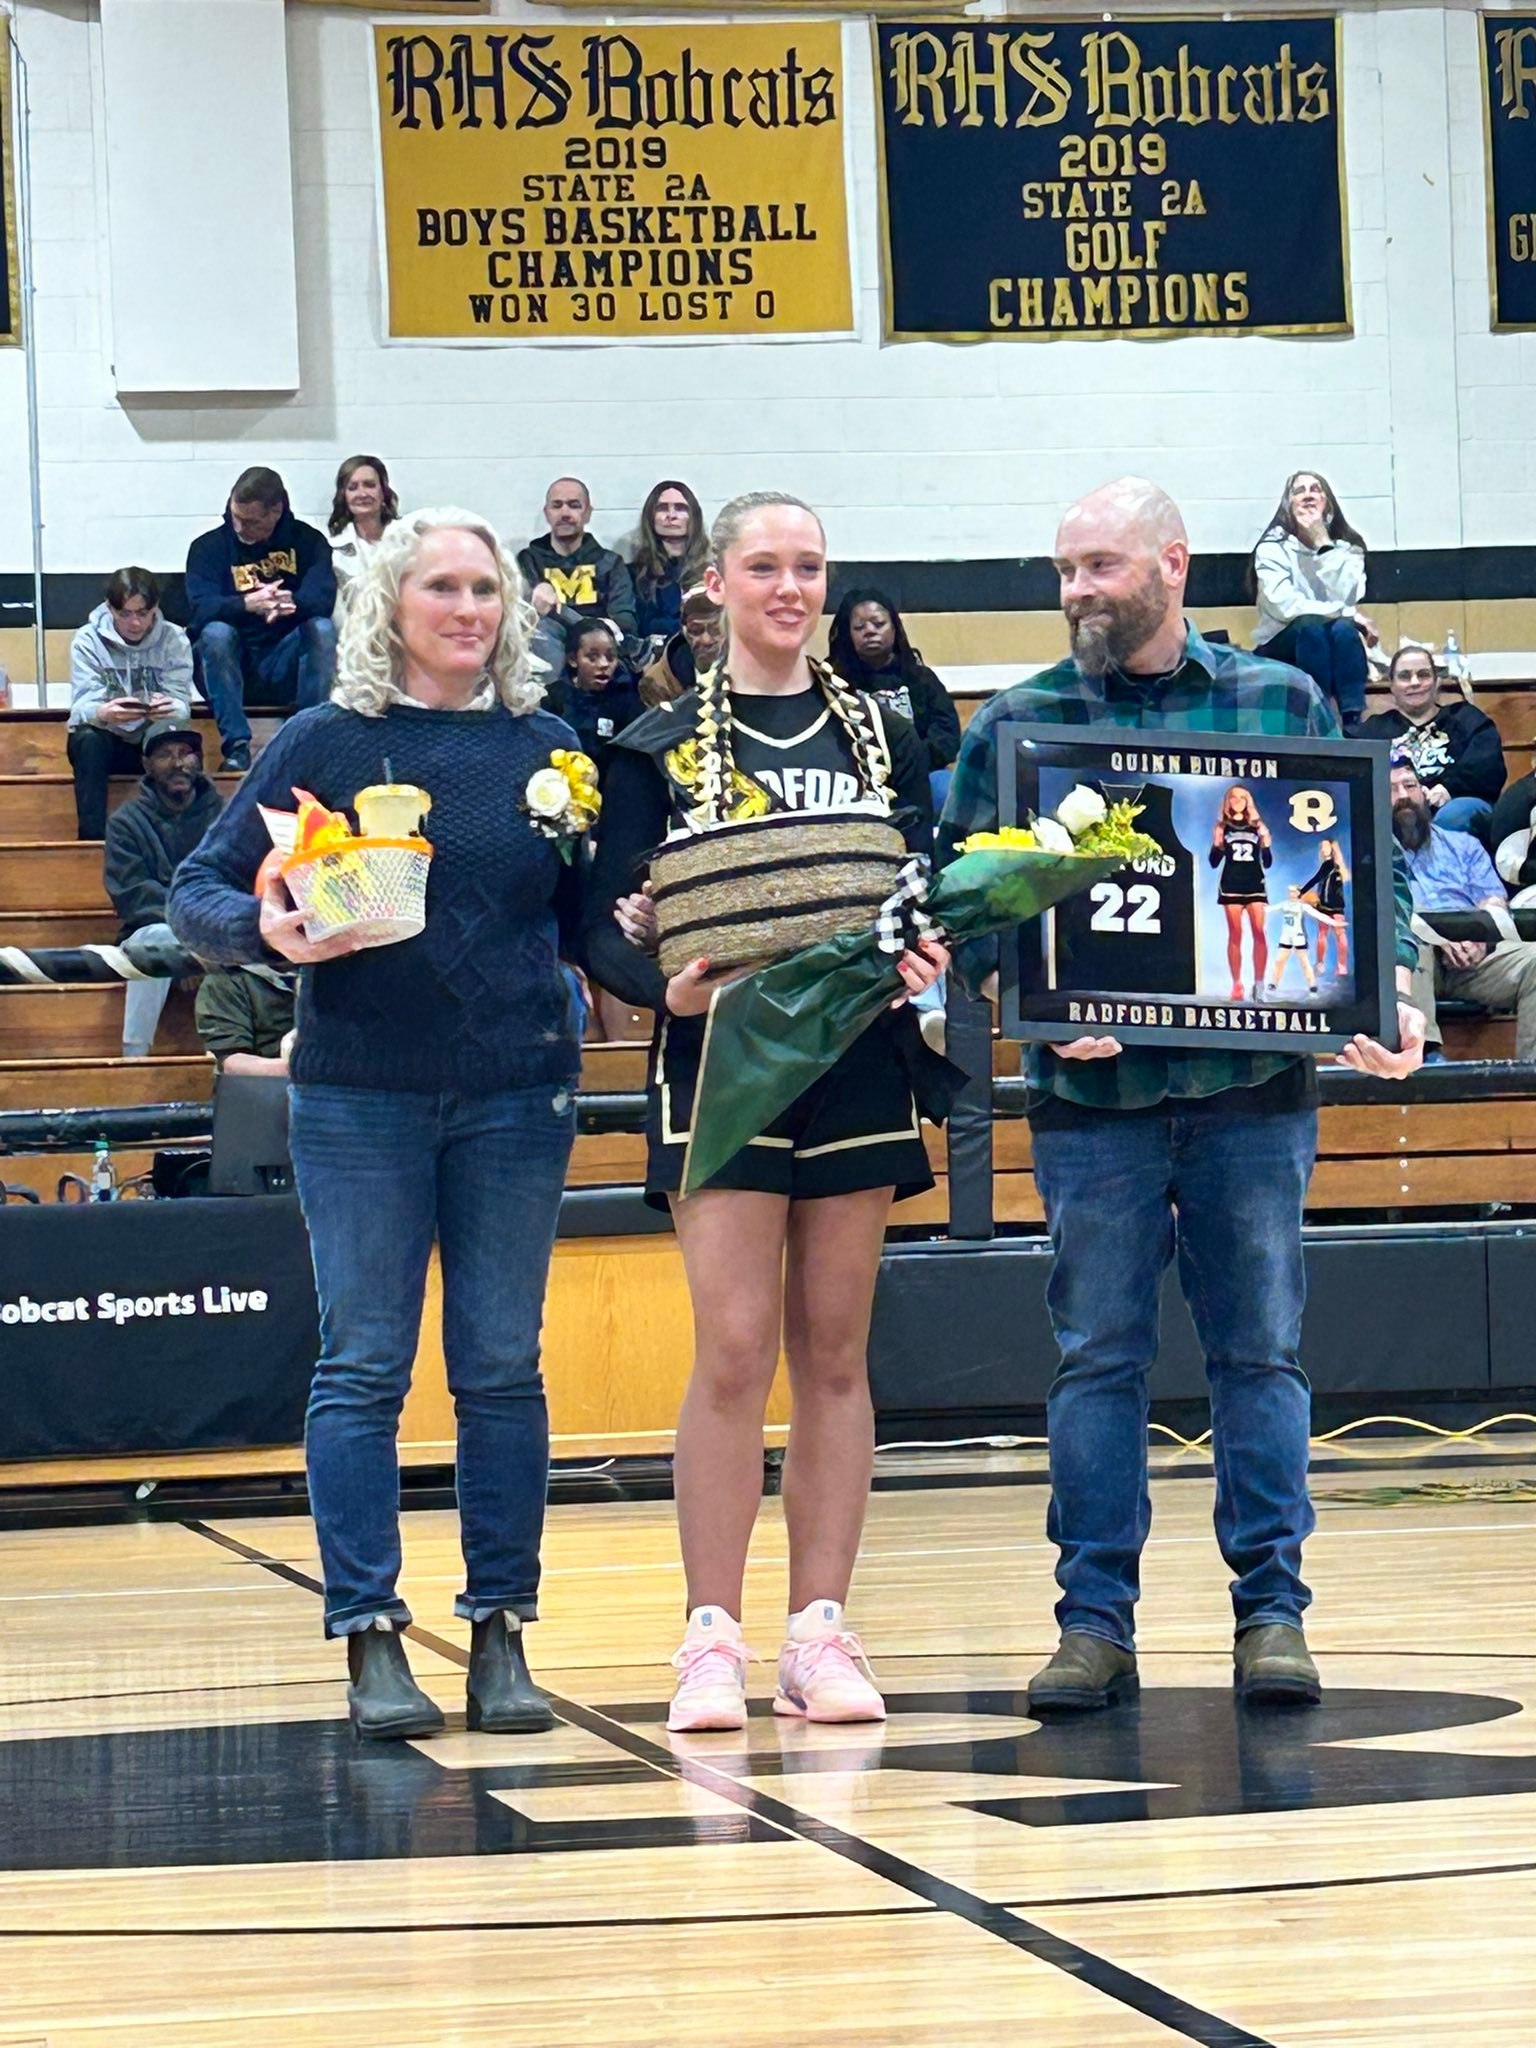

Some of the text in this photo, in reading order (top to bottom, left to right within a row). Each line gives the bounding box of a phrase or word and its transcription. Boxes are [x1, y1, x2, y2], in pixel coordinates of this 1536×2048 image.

[386, 33, 837, 131] RHS Bobcats
[889, 30, 1330, 129] RHS Bobcats
[564, 136, 667, 169] 2019
[1059, 133, 1167, 178] 2019
[523, 173, 711, 203] STATE 2A
[1022, 179, 1207, 219] STATE 2A
[416, 203, 817, 247] BOYS BASKETBALL
[1065, 220, 1167, 272] GOLF
[488, 248, 754, 289] CHAMPIONS
[469, 290, 776, 325] WON 30 LOST 0
[989, 271, 1250, 328] CHAMPIONS
[544, 564, 597, 605] M
[1111, 752, 1278, 779] QUINN BURTON
[1288, 789, 1338, 833] R
[1090, 882, 1162, 934] 22
[1069, 1001, 1331, 1033] RADFORD BASKETBALL
[0, 1286, 269, 1326] obcat Sports Live
